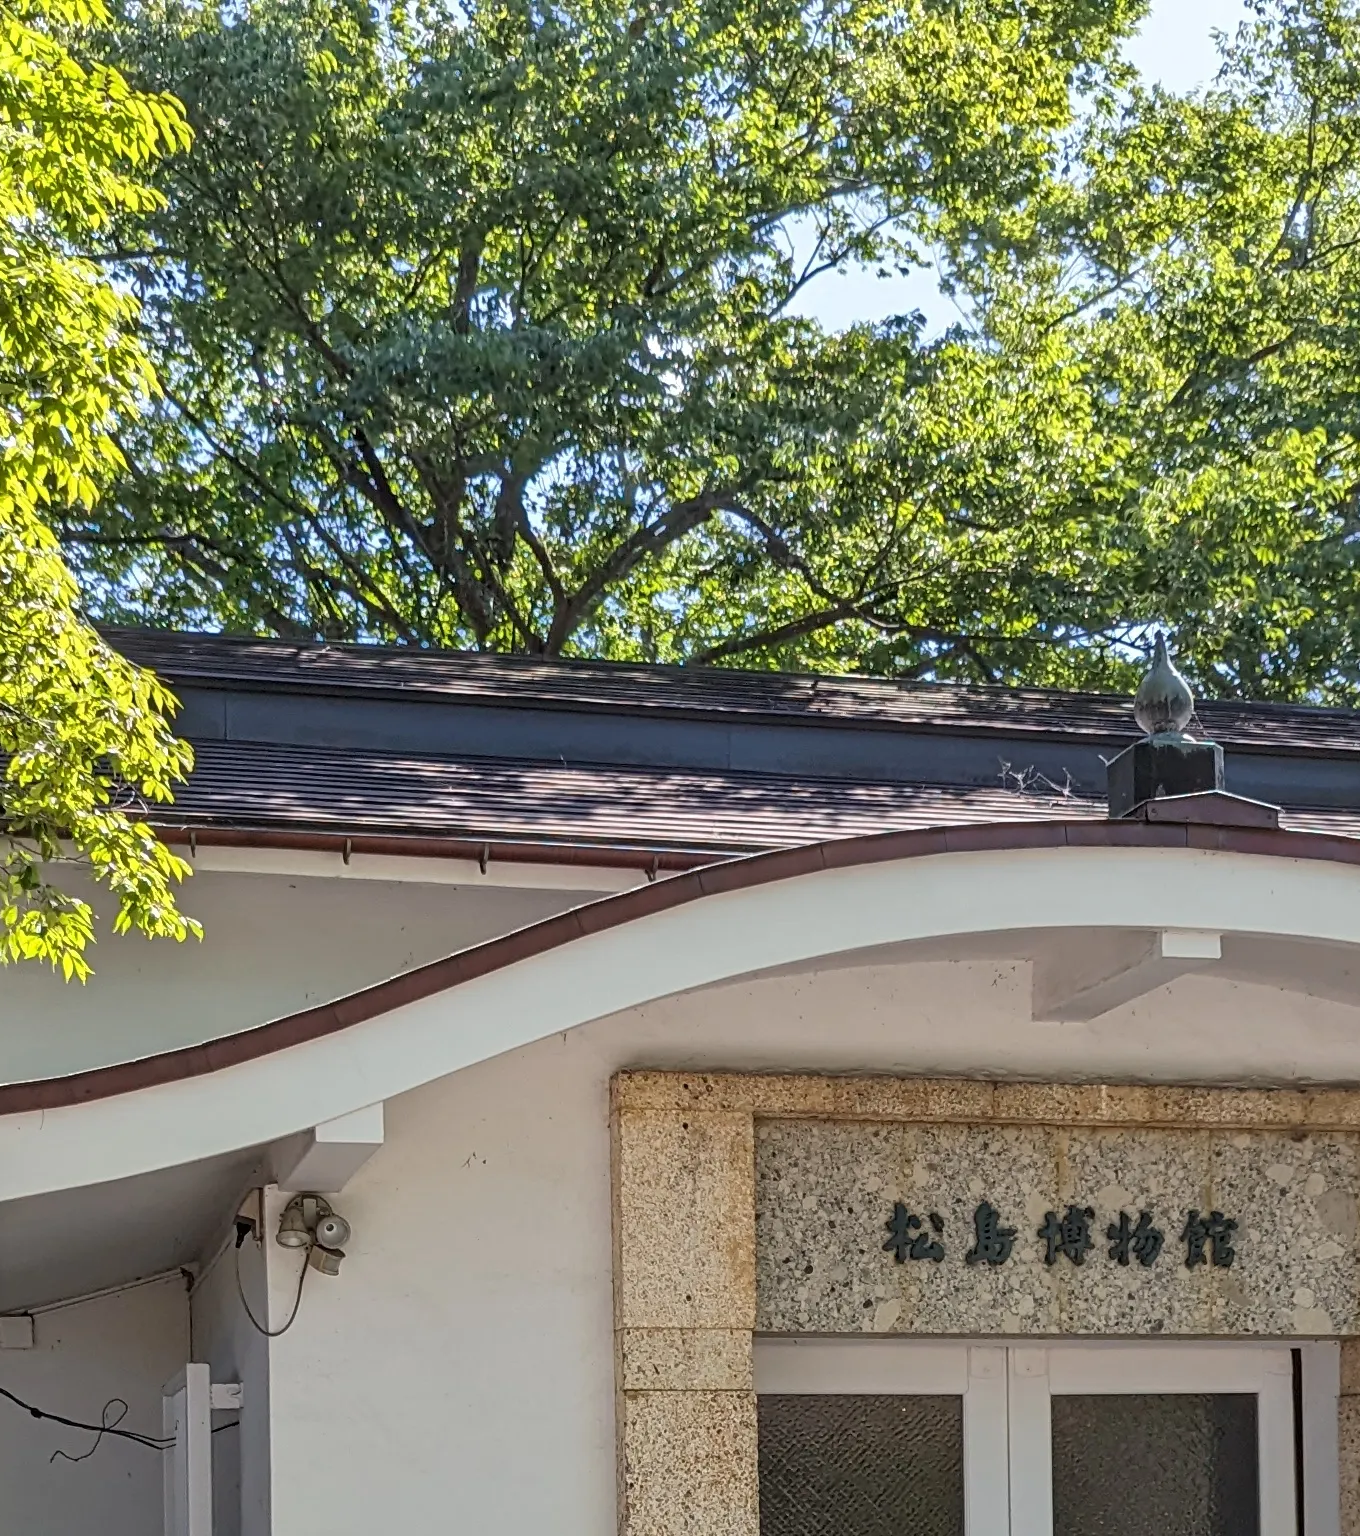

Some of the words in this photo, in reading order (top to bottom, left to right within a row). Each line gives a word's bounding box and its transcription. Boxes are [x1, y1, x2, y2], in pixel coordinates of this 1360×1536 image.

[882, 1202, 1240, 1269] 松島博物館
